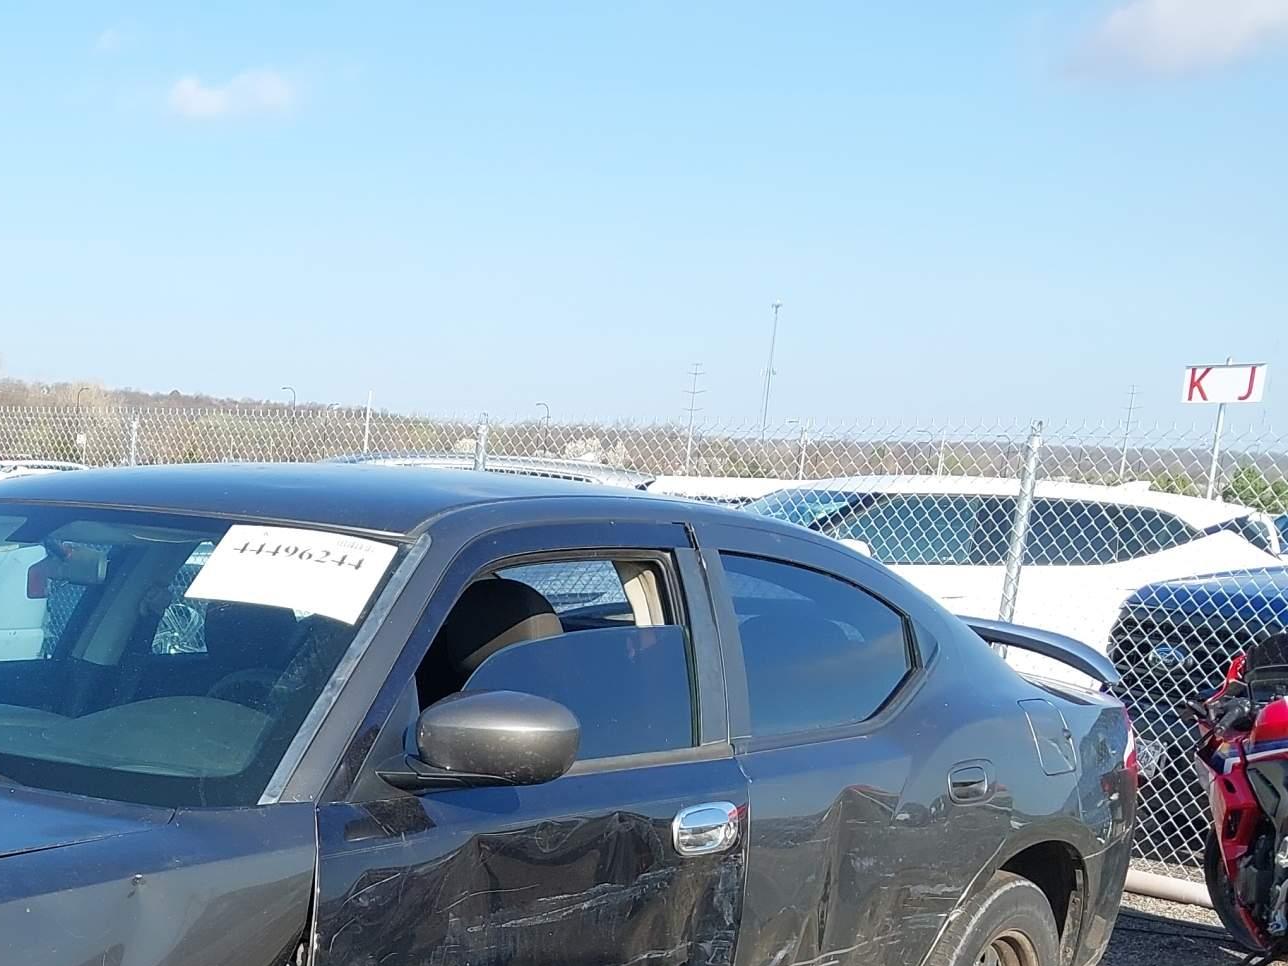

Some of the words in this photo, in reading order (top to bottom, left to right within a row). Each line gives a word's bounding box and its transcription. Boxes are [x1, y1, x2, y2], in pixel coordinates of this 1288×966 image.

[1187, 367, 1214, 402] K
[1237, 366, 1257, 401] J
[233, 541, 365, 571] 44496244
